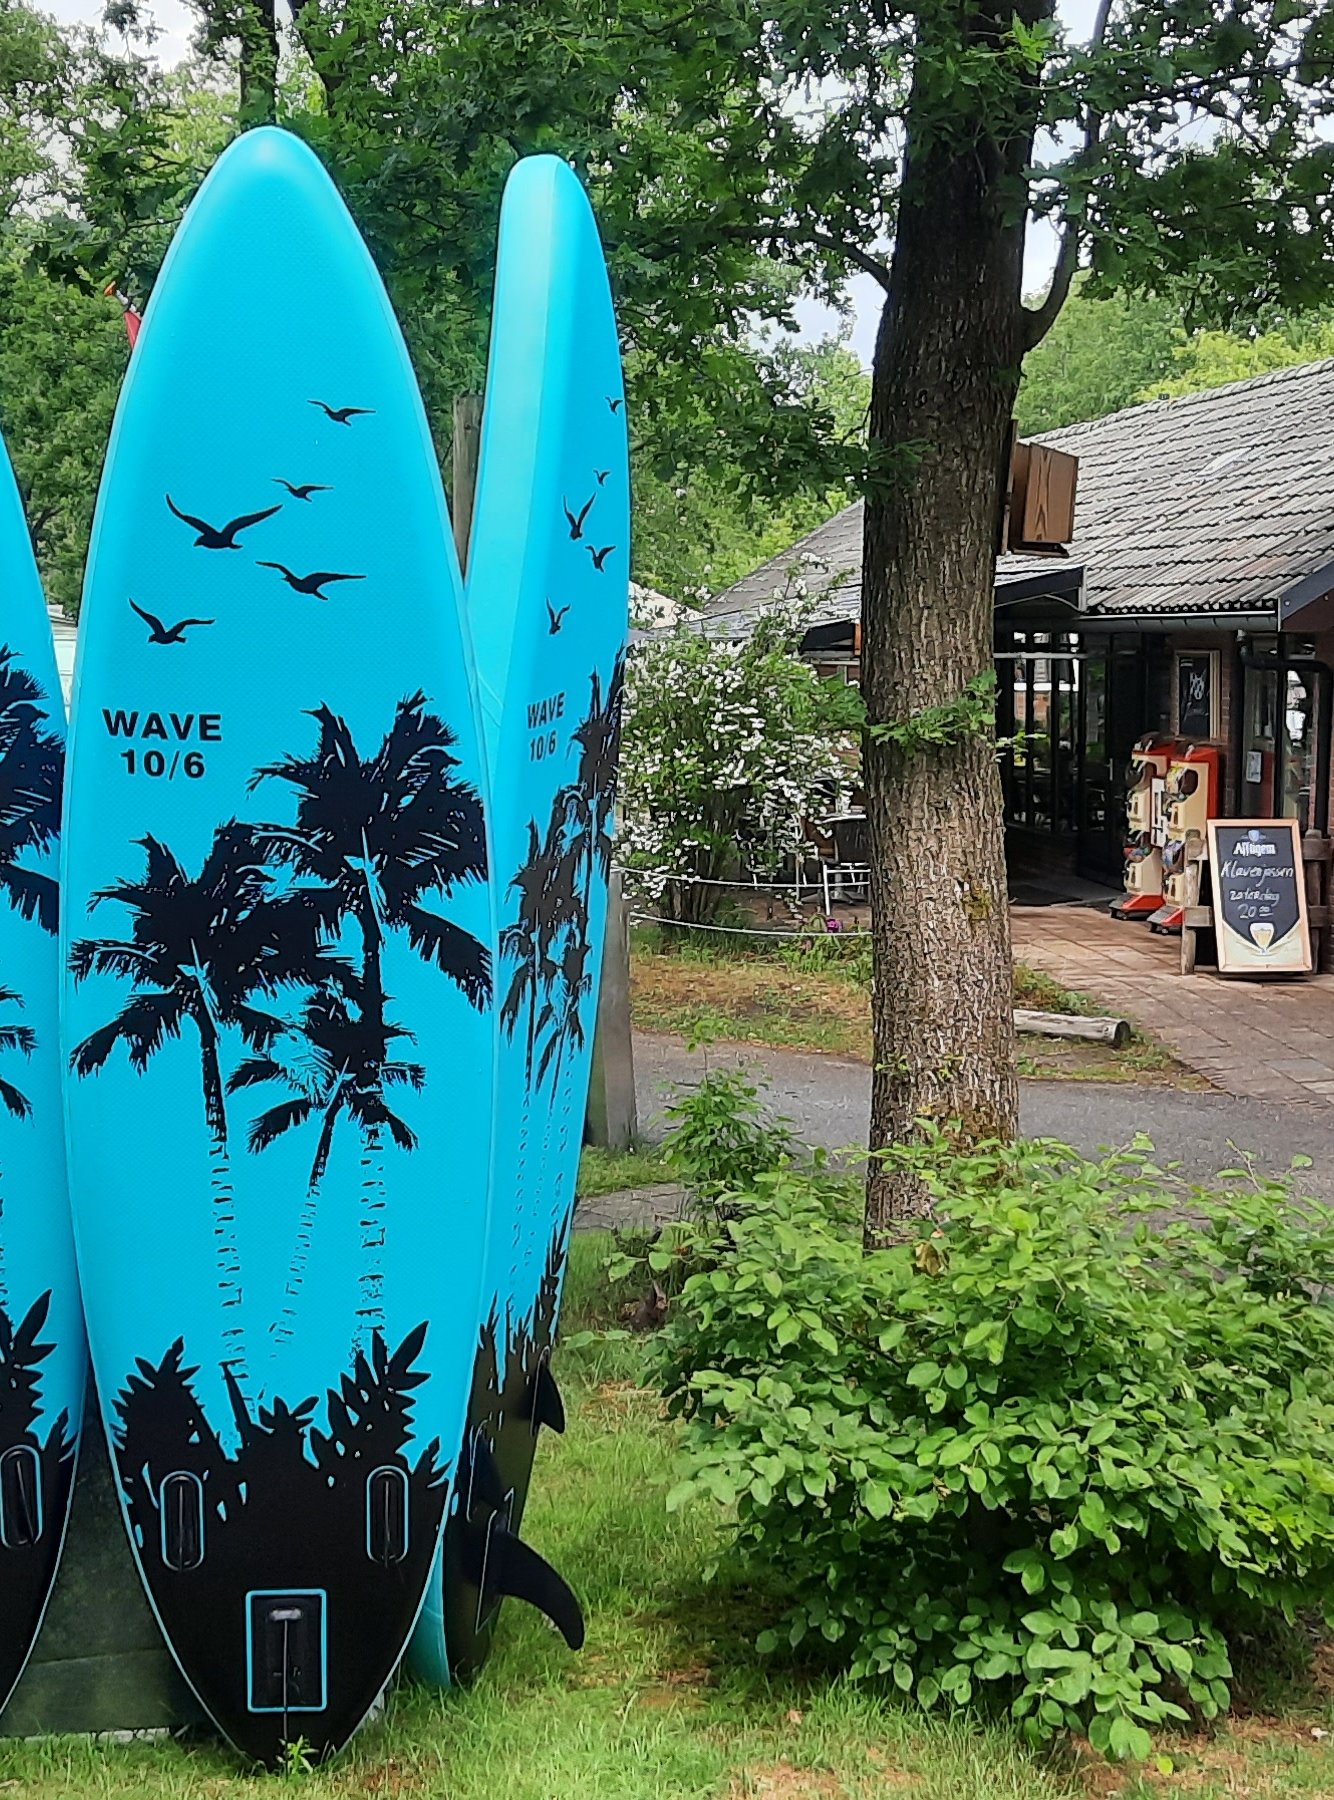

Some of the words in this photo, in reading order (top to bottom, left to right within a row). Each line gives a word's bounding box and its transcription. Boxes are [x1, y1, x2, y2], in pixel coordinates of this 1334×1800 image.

[102, 709, 223, 741] WAVE
[527, 691, 565, 729] WAVE
[530, 730, 557, 762] 10/6
[119, 749, 206, 780] 10/6
